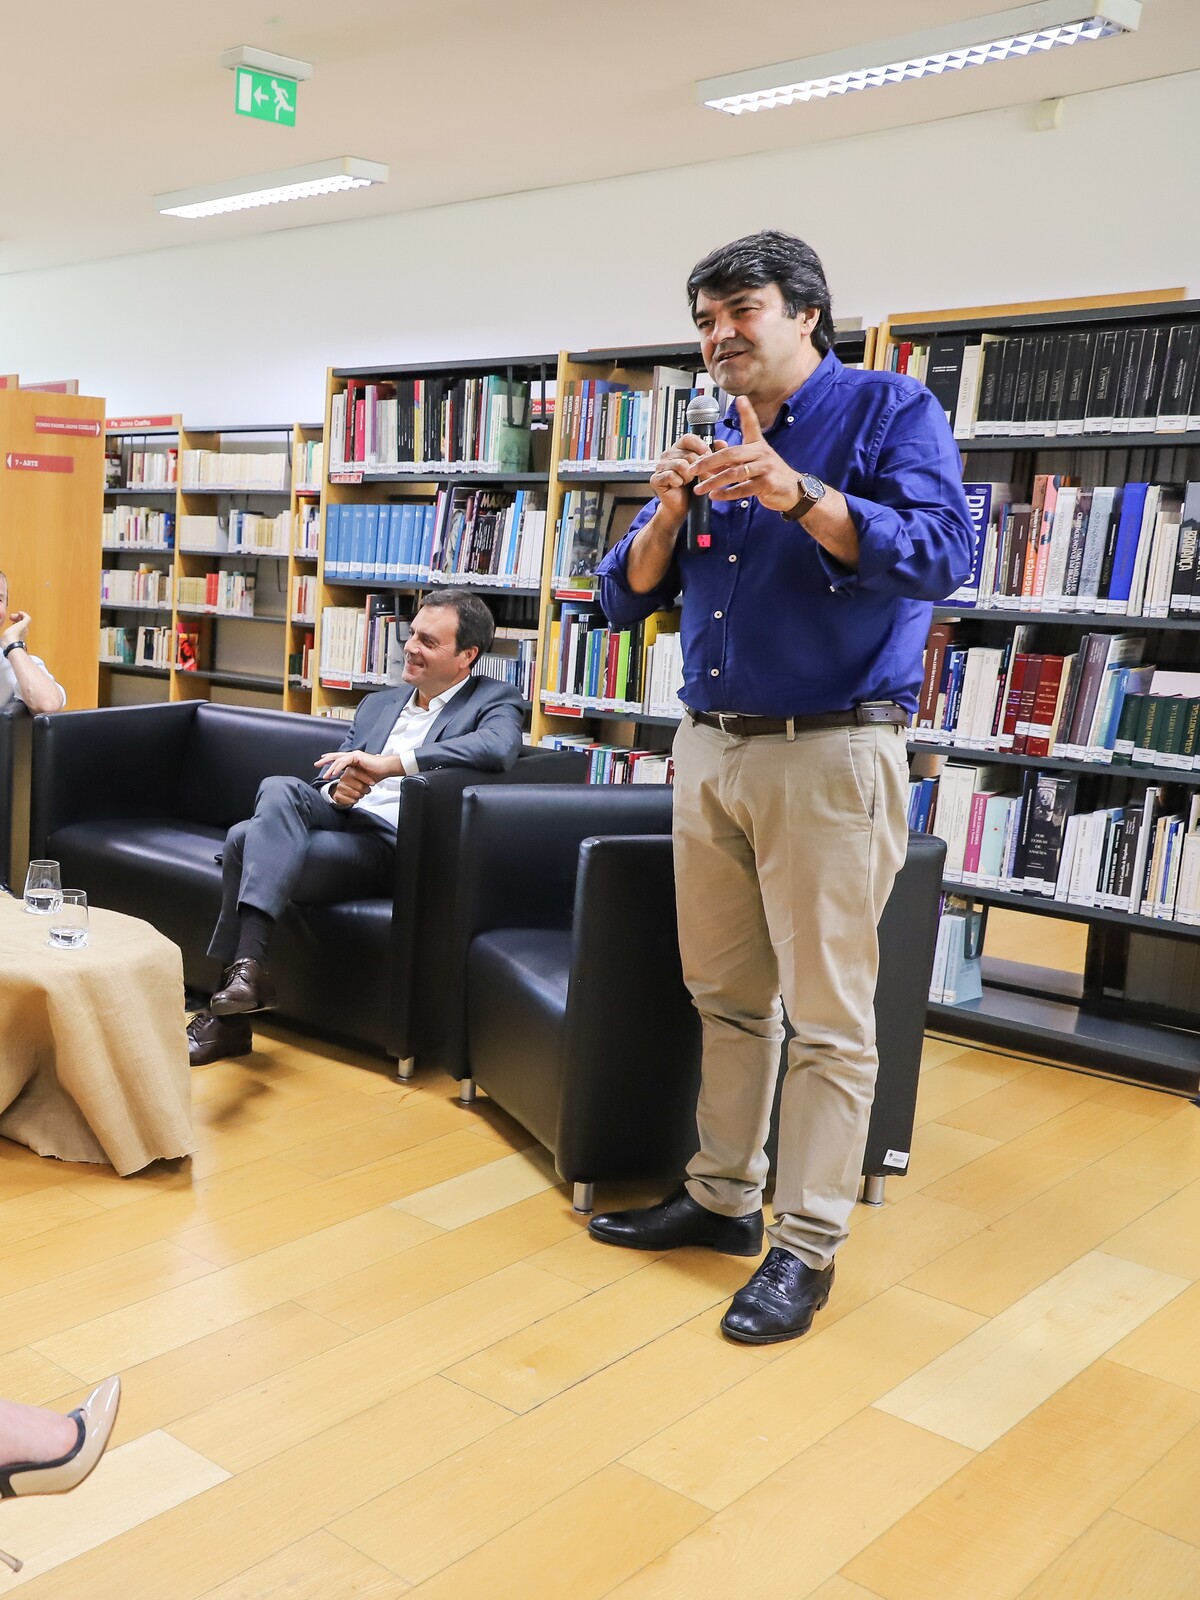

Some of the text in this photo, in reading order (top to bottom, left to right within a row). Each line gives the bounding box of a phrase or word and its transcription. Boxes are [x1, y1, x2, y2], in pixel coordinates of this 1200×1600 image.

[133, 419, 151, 427] Coelho
[23, 460, 39, 468] ARTE
[1176, 530, 1198, 571] BRAGANÇA
[1187, 704, 1199, 734] PORTUGAL
